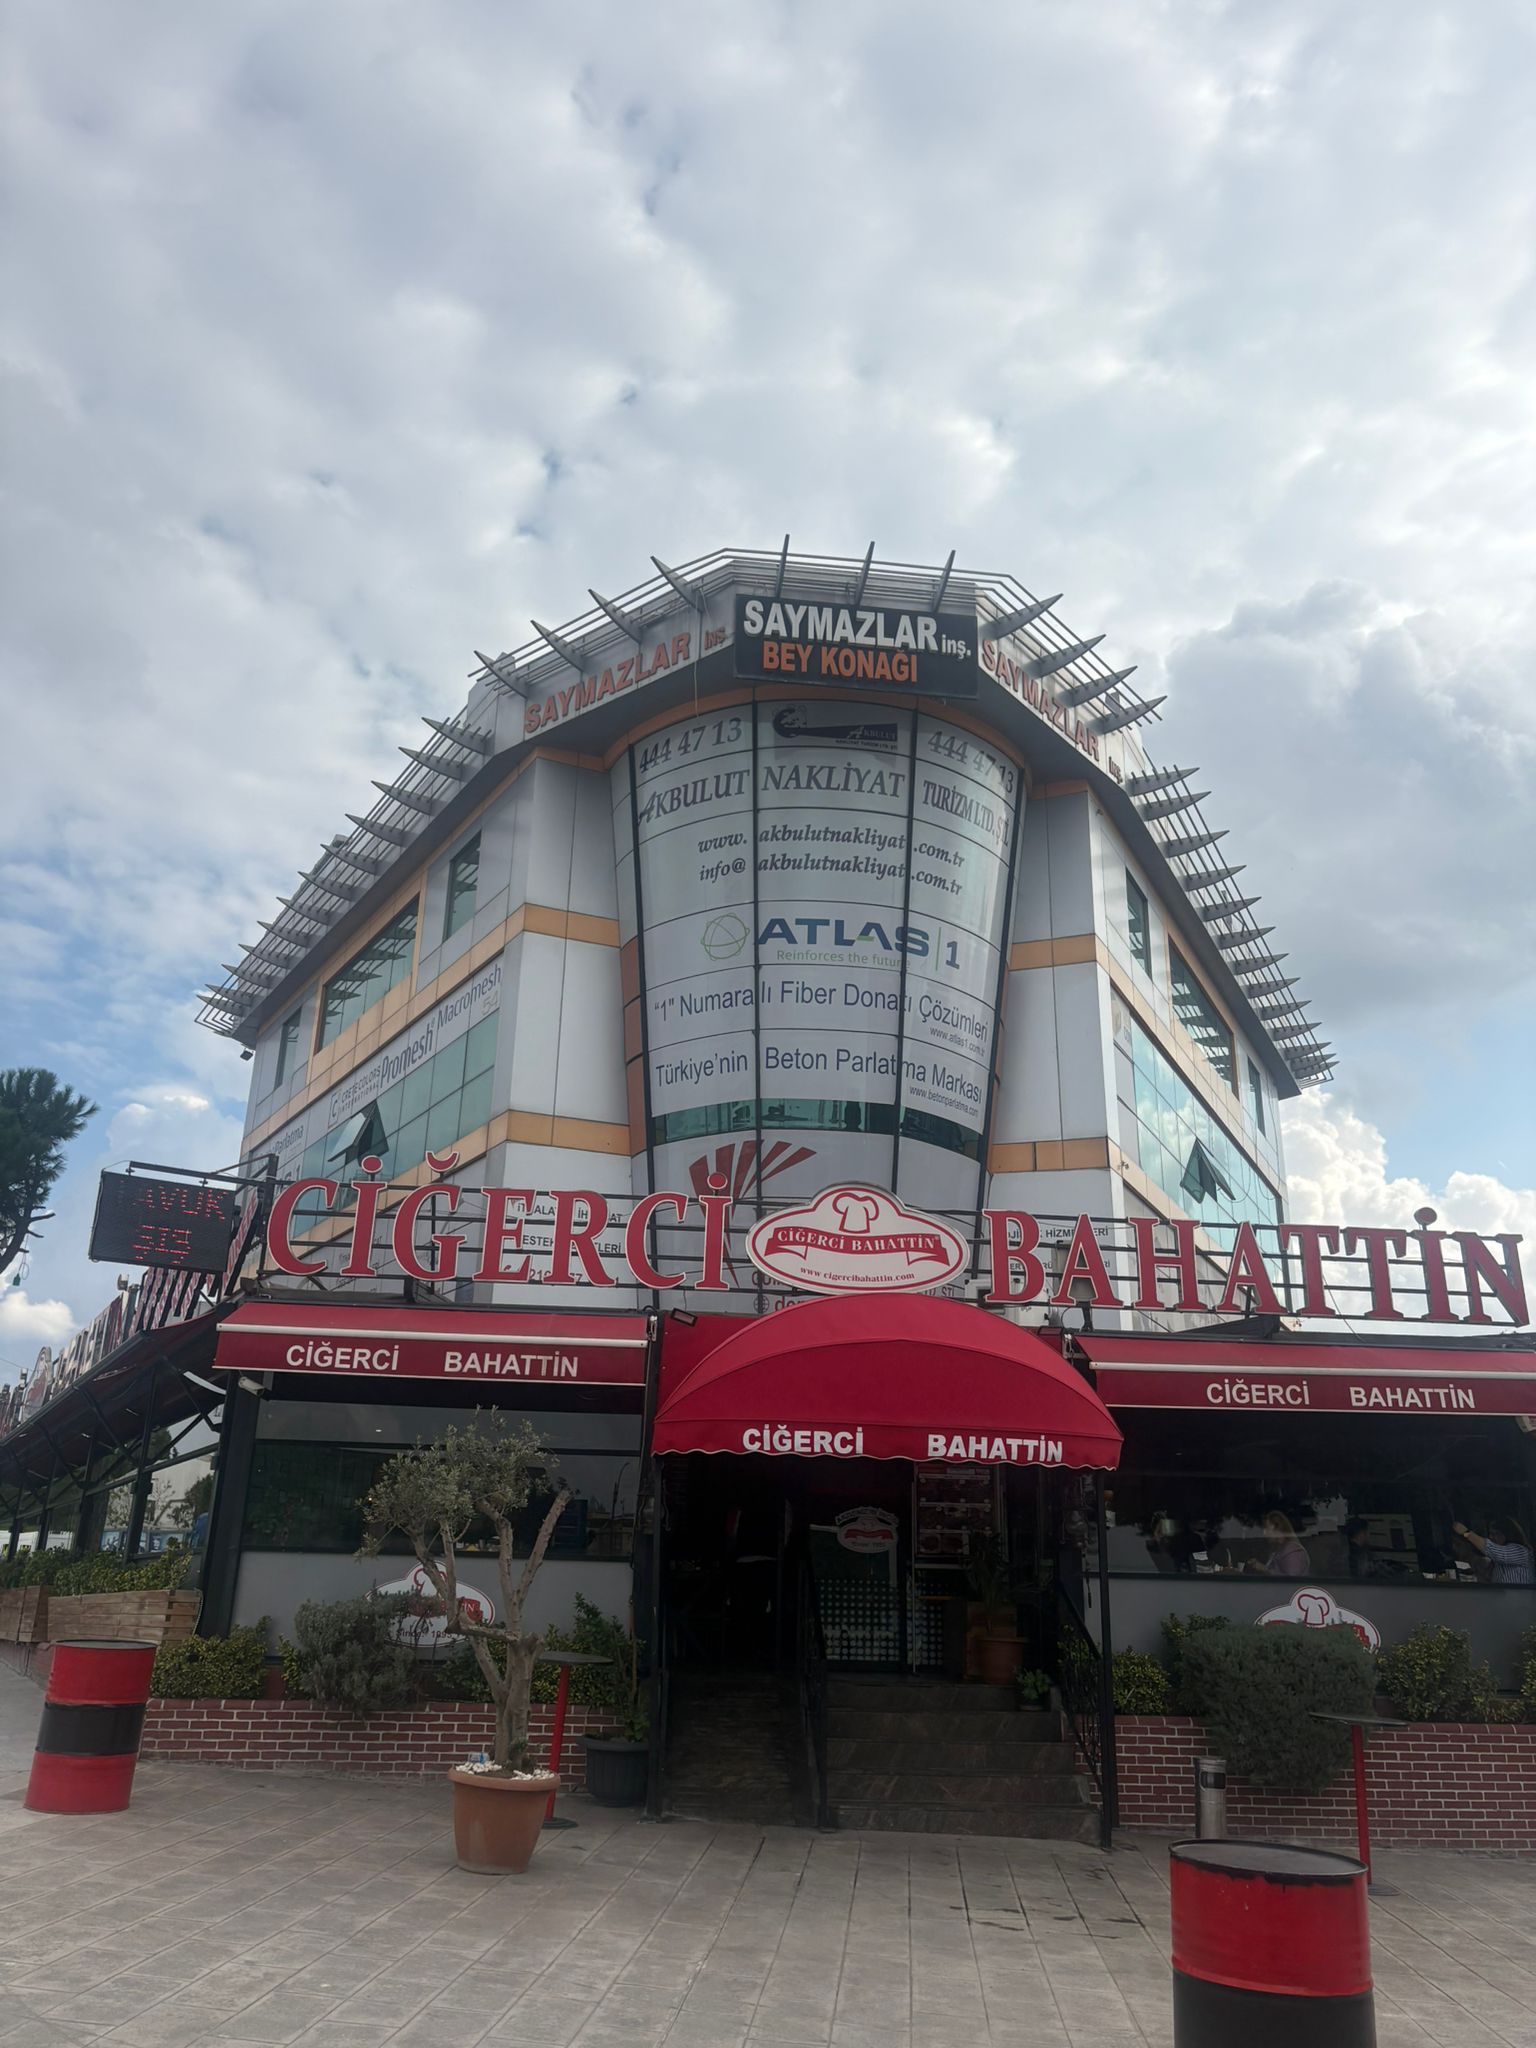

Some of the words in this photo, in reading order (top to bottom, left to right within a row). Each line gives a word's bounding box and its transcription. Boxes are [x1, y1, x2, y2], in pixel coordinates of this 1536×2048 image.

[744, 600, 938, 651] SAYMAZLAR
[942, 634, 972, 659] inş.
[524, 632, 691, 734] SAYMAZLAR
[763, 641, 813, 673] BEY
[821, 646, 918, 683] KONAĞI
[982, 639, 1099, 762] SAYMAZLAR
[640, 738, 672, 774] 444
[678, 725, 706, 756] 47
[712, 717, 742, 746] 13
[928, 731, 968, 765] 444
[973, 750, 996, 776] 47
[638, 769, 750, 826] AKBULUT
[761, 762, 906, 798] NAKLİYAT
[922, 779, 973, 821] TURİZM
[698, 833, 747, 853] www.
[699, 857, 746, 884] info@
[758, 917, 930, 958] ATLAS
[945, 940, 961, 970] 1
[777, 950, 844, 962] Reinforces
[849, 953, 868, 964] the
[438, 964, 502, 1031] Macromesh
[680, 980, 771, 1017] Numaralı
[781, 980, 836, 1005] Fiber
[919, 995, 988, 1043] Çözümleri
[765, 1047, 827, 1071] Beton
[836, 1049, 926, 1082] Parlatma
[932, 1063, 982, 1104] Markası
[267, 1151, 734, 1291] CİĞERCİ
[982, 1207, 1530, 1327] BAHATTİN
[777, 1227, 844, 1250] CİĞERCİ
[851, 1237, 935, 1252] BAHATTİN
[286, 1341, 400, 1371] CİĞERCİ
[444, 1350, 578, 1378] BAHATTİN
[1206, 1378, 1310, 1405] CİĞERCİ
[1350, 1384, 1476, 1409] BAHATTİN
[742, 1423, 864, 1454] CİĞERCİ
[927, 1434, 1063, 1463] BAHATTİN
